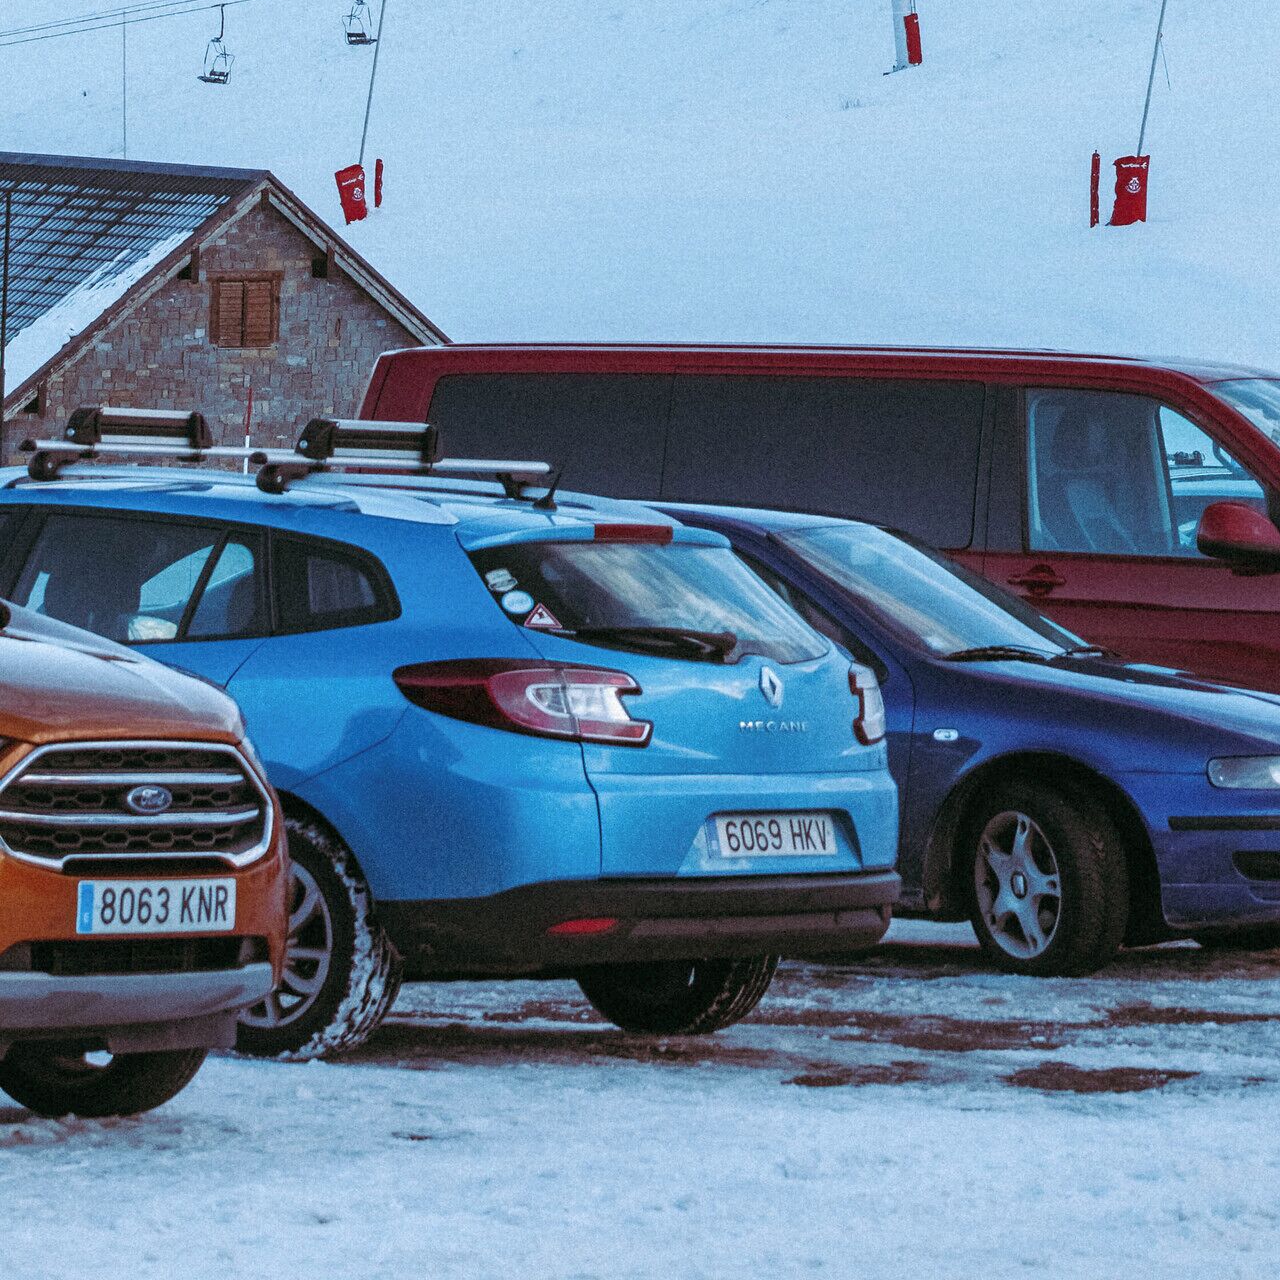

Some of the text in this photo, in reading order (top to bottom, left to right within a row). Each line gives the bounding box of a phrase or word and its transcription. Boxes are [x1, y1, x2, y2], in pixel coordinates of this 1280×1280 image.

[725, 818, 828, 852] 6069 HKV
[100, 884, 229, 925] 8063 KNR
